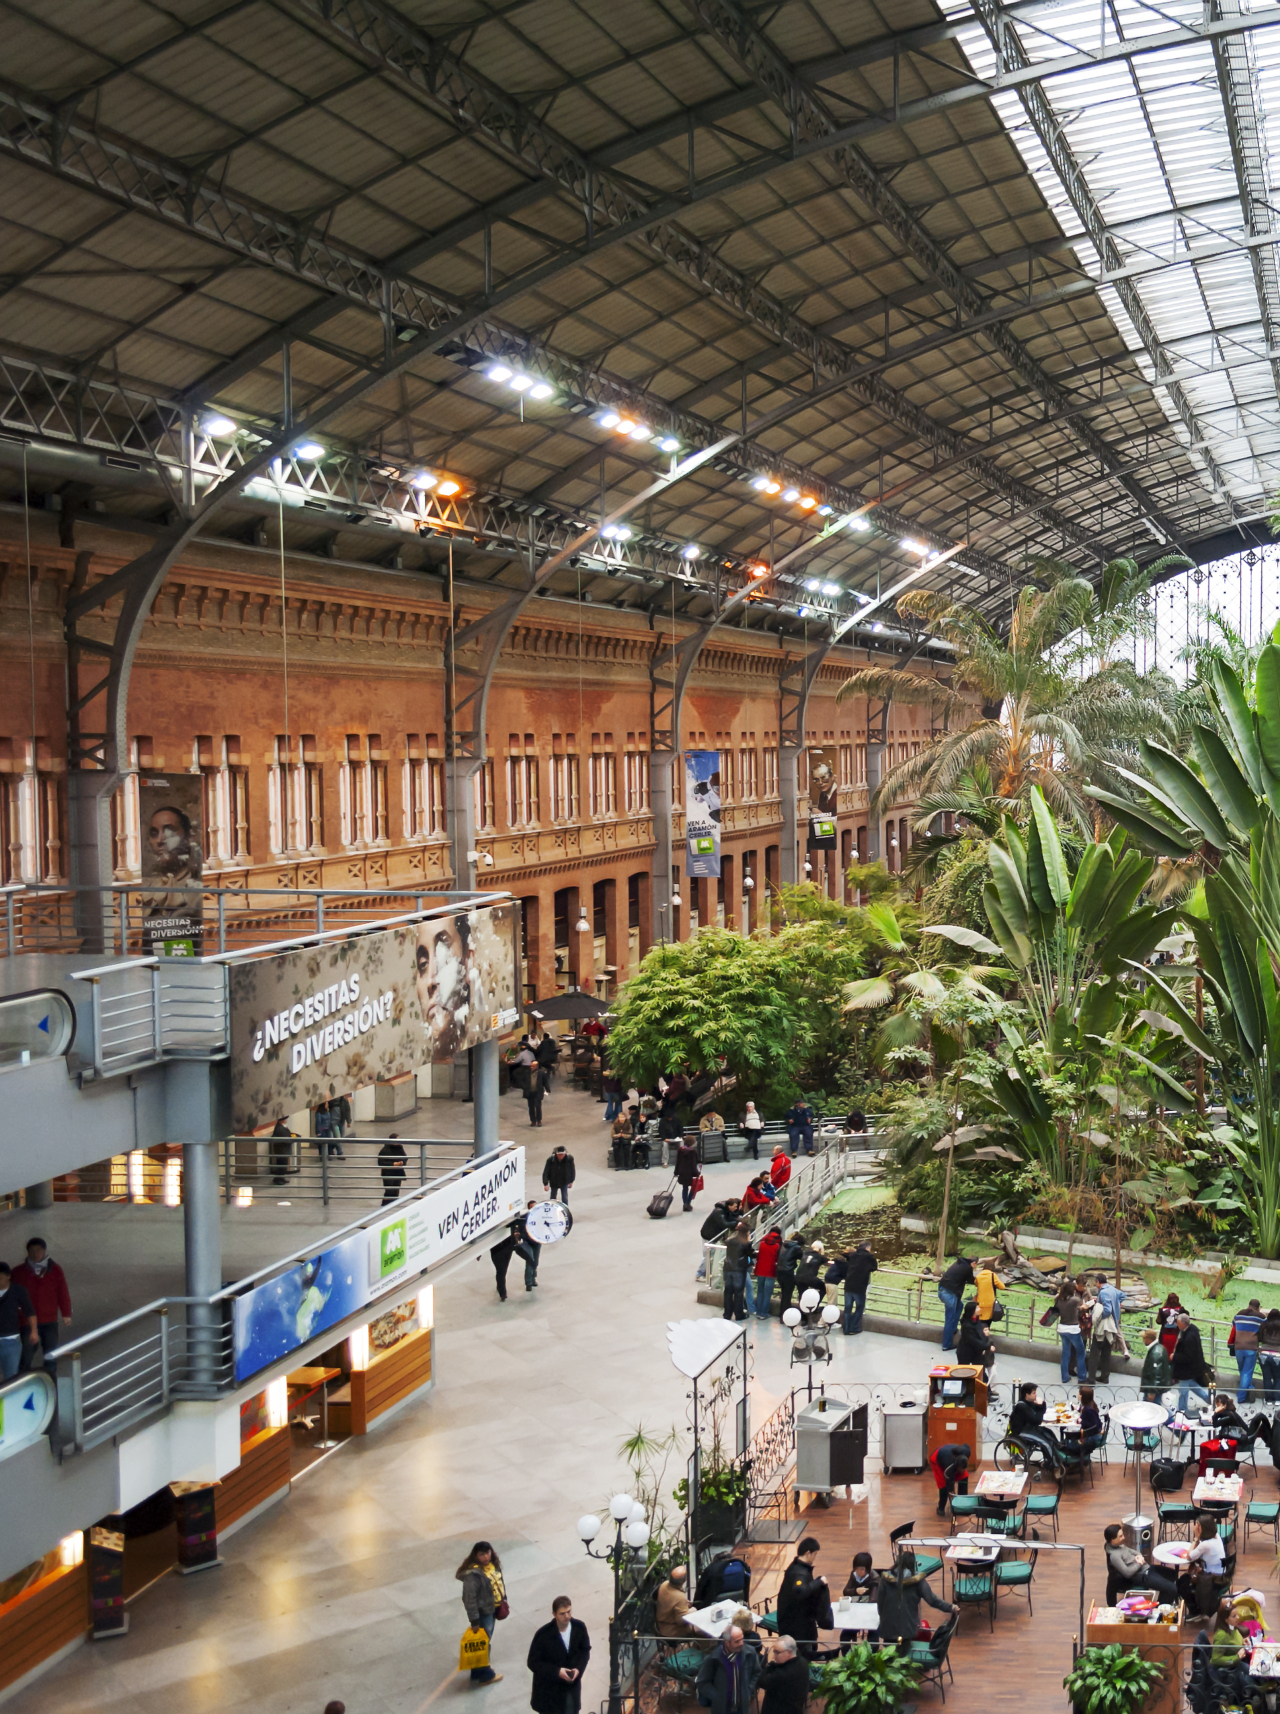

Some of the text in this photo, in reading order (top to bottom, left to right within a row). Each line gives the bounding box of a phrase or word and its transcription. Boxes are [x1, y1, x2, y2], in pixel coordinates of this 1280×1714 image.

[253, 973, 360, 1063] ¿NECESITAS
[291, 991, 394, 1075] DIVERSIÓN?
[438, 1207, 459, 1240] VEN
[462, 1200, 470, 1219] A
[473, 1157, 518, 1211] ARAMÓN
[460, 1197, 500, 1241] CERLER.
